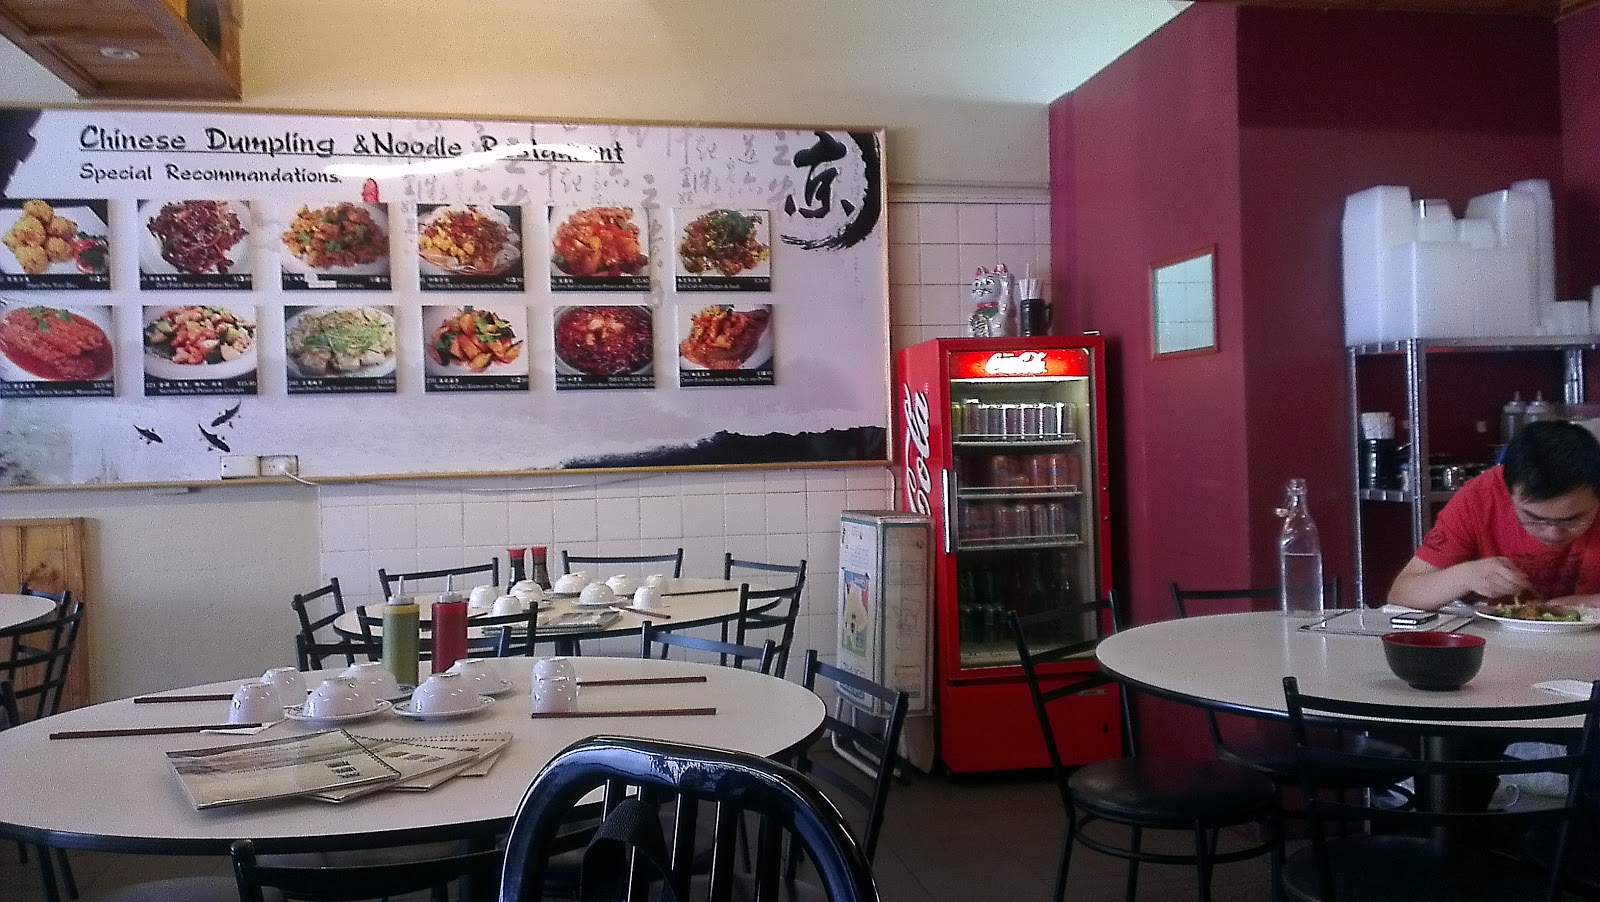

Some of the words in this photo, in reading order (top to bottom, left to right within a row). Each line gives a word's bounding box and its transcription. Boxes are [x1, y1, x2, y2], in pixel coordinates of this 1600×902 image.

[79, 124, 186, 150] Chinese
[205, 127, 335, 157] Dumpling
[79, 162, 152, 183] Special
